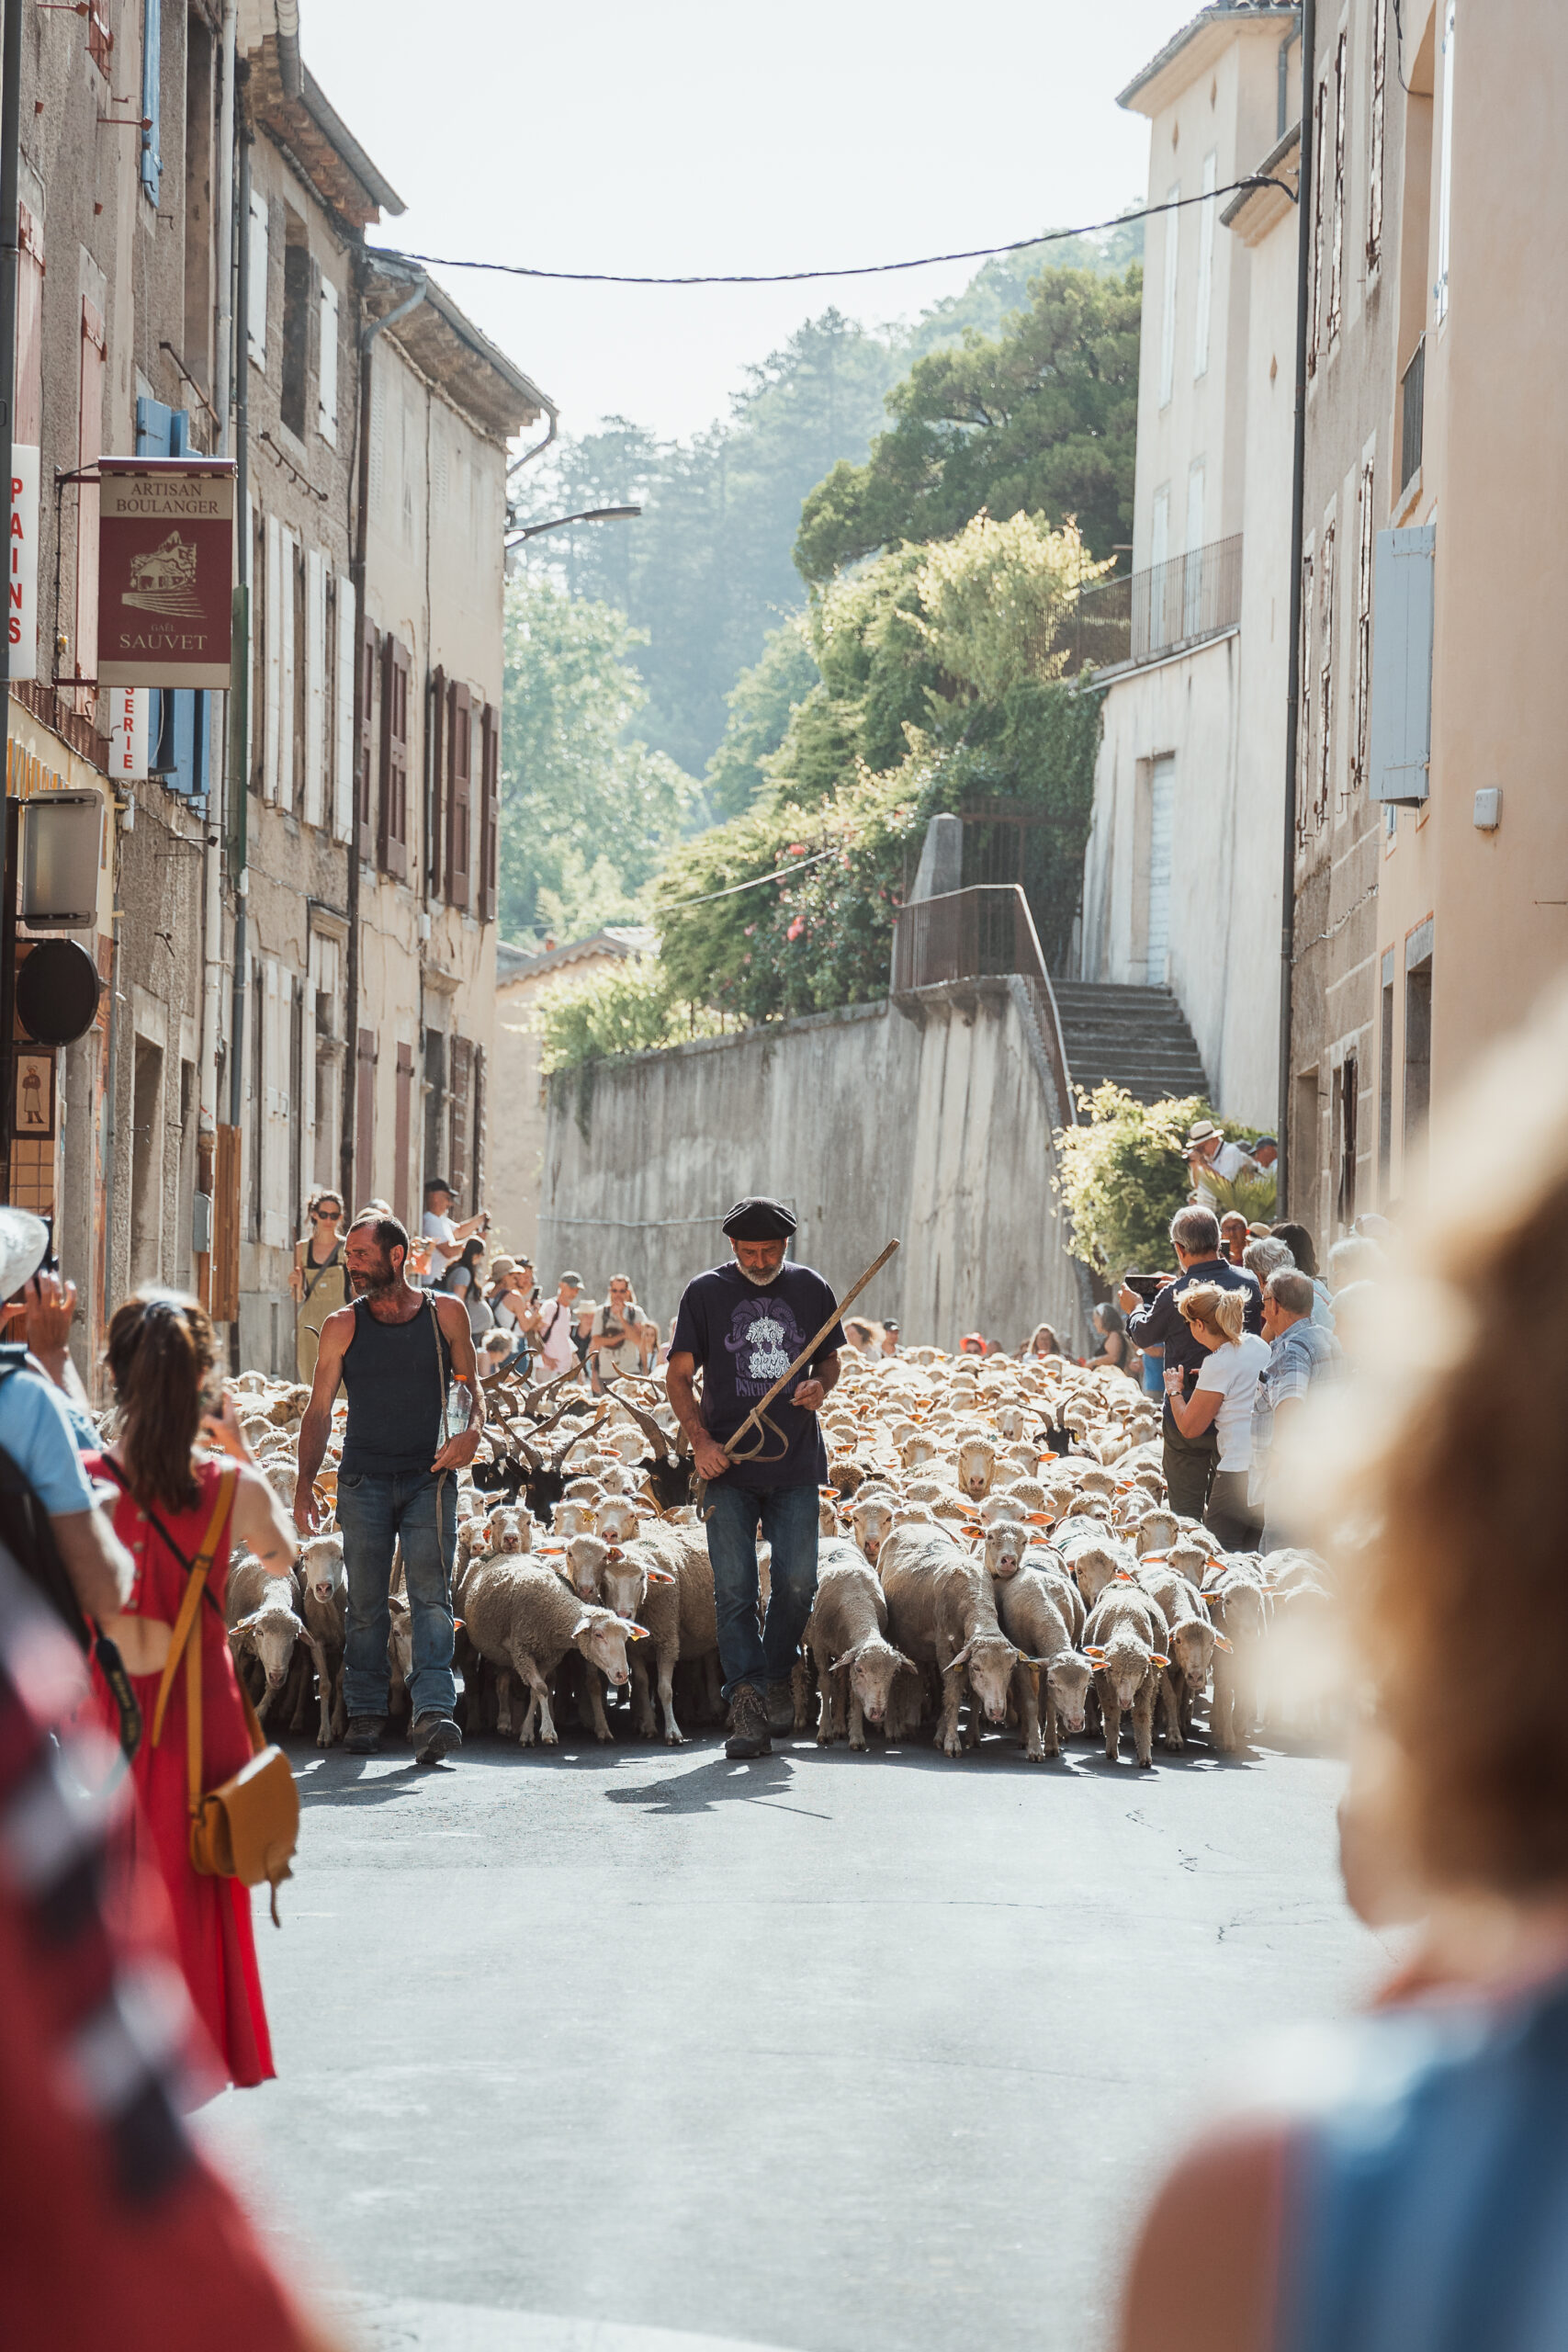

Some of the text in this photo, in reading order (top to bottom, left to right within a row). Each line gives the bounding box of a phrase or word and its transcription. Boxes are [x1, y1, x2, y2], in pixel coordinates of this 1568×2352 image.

[131, 482, 202, 496] ARTISAN
[116, 499, 220, 514] BOULANGER
[9, 477, 24, 644] PAINS
[119, 633, 208, 650] SAUVET
